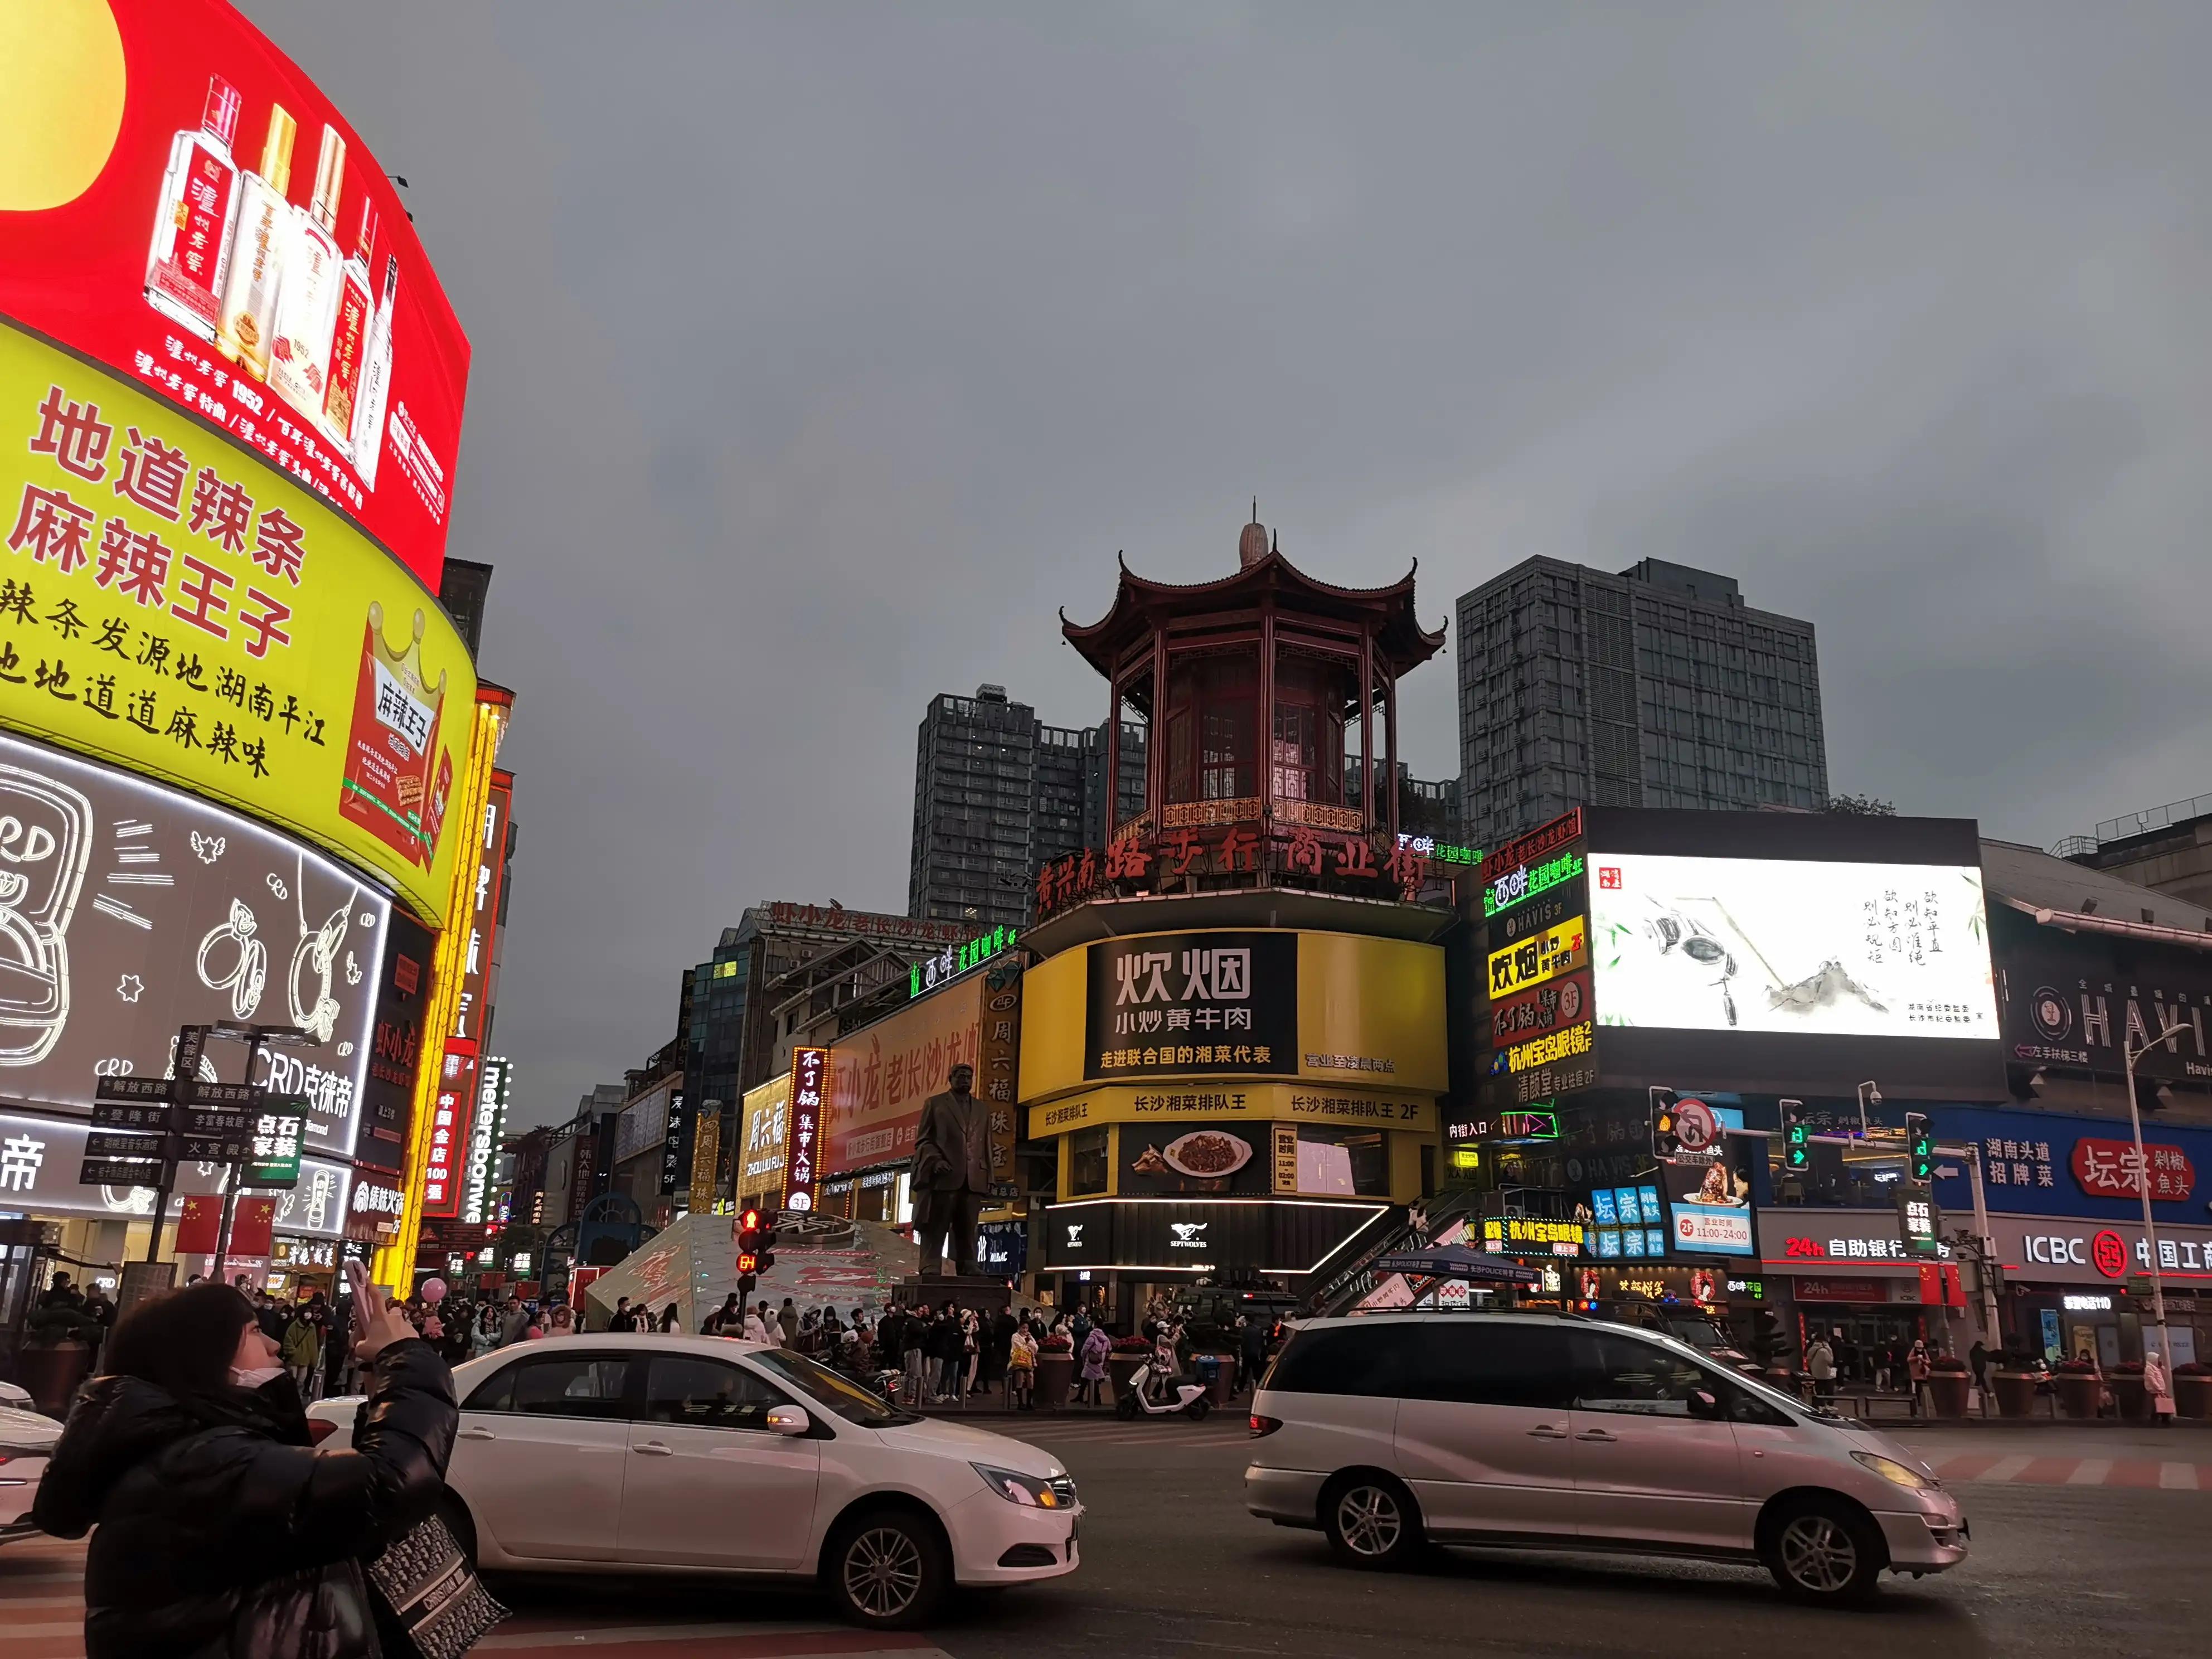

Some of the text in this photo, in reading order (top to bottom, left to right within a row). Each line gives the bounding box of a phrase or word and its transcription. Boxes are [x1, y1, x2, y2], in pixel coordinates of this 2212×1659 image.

[294, 339, 309, 358] 1952
[166, 334, 229, 387] 泸州老窖
[232, 379, 264, 416] 1952
[28, 384, 307, 588] 地道辣条
[7, 483, 293, 660] 麻辣王子
[378, 681, 430, 748] 麻辣王子
[1036, 827, 1430, 915] 黄兴南路步行商业街
[1571, 857, 1583, 874] 4F
[1517, 903, 1551, 933] HAVIS
[1884, 889, 1901, 952] 欲知方圆
[1924, 891, 1943, 952] 欲知平直
[1570, 933, 1582, 952] 2F
[1863, 899, 1884, 963] 则必规矩
[1115, 948, 1251, 1005] 炊烟
[1490, 943, 1539, 993] 炊烟
[1563, 989, 1578, 1011] 3F
[1115, 1007, 1251, 1035] 小炒黄牛肉
[181, 1031, 198, 1068] 芙蓉区
[337, 1041, 354, 1056] CRD
[1100, 1045, 1271, 1069] 走进联合国的湘菜代表
[1508, 1028, 1585, 1074] 杭州宝岛眼镜
[2032, 1045, 2089, 1064] 左手扶梯三楼
[94, 1058, 134, 1076] CRD
[1304, 1052, 1396, 1074] 营业至凌晨两点
[113, 1080, 168, 1095] 解放西路
[252, 1047, 354, 1118] CRD 克徕帝
[797, 1051, 820, 1107] 不了锅
[1518, 1069, 1595, 1103] 清颜堂 专业祛痘 2F
[197, 1086, 250, 1100] 解放西路
[988, 1021, 1011, 1167] 周六福珠宝
[1134, 1094, 1246, 1113] 长沙湘菜排队王
[110, 1109, 161, 1123] 登隆街
[1045, 1102, 1088, 1126] 长沙湘菜排队王
[1291, 1095, 1419, 1120] 长沙湘菜排队王 2F
[195, 1115, 245, 1128] 李富春故居
[257, 1114, 301, 1136] 点石
[749, 1099, 785, 1152] 周六福
[1449, 1122, 1487, 1138] 内街入口
[188, 1142, 240, 1155] 火宫殿
[252, 1137, 297, 1158] 家装
[465, 1066, 501, 1224] metersbonwe
[793, 1114, 814, 1183] 集市火锅
[1278, 1134, 1294, 1144] 营业
[1278, 1144, 1294, 1155] 时间
[1985, 1137, 2051, 1162] 湖南头道
[0, 1133, 46, 1191] 帝
[2084, 1145, 2152, 1192] 坛宗
[2154, 1149, 2187, 1172] 剁椒
[664, 1175, 676, 1183] 5F
[1989, 1161, 2054, 1187] 招牌菜
[792, 1198, 808, 1209] 3F
[1596, 1192, 1638, 1220] 坛宗
[1906, 1201, 1929, 1217] 点石
[1509, 1221, 1584, 1243] 杭州宝岛眼镜
[1681, 1223, 1694, 1233] 2F
[1697, 1228, 1748, 1239] 11:00-24:00
[1907, 1217, 1932, 1234] 家装
[1599, 1232, 1643, 1255] 坛宗
[1786, 1236, 1951, 1258] 24h 自助银行务
[2024, 1235, 2086, 1265] ICBC
[739, 1256, 755, 1269] 64
[1803, 1282, 1829, 1294] 24h
